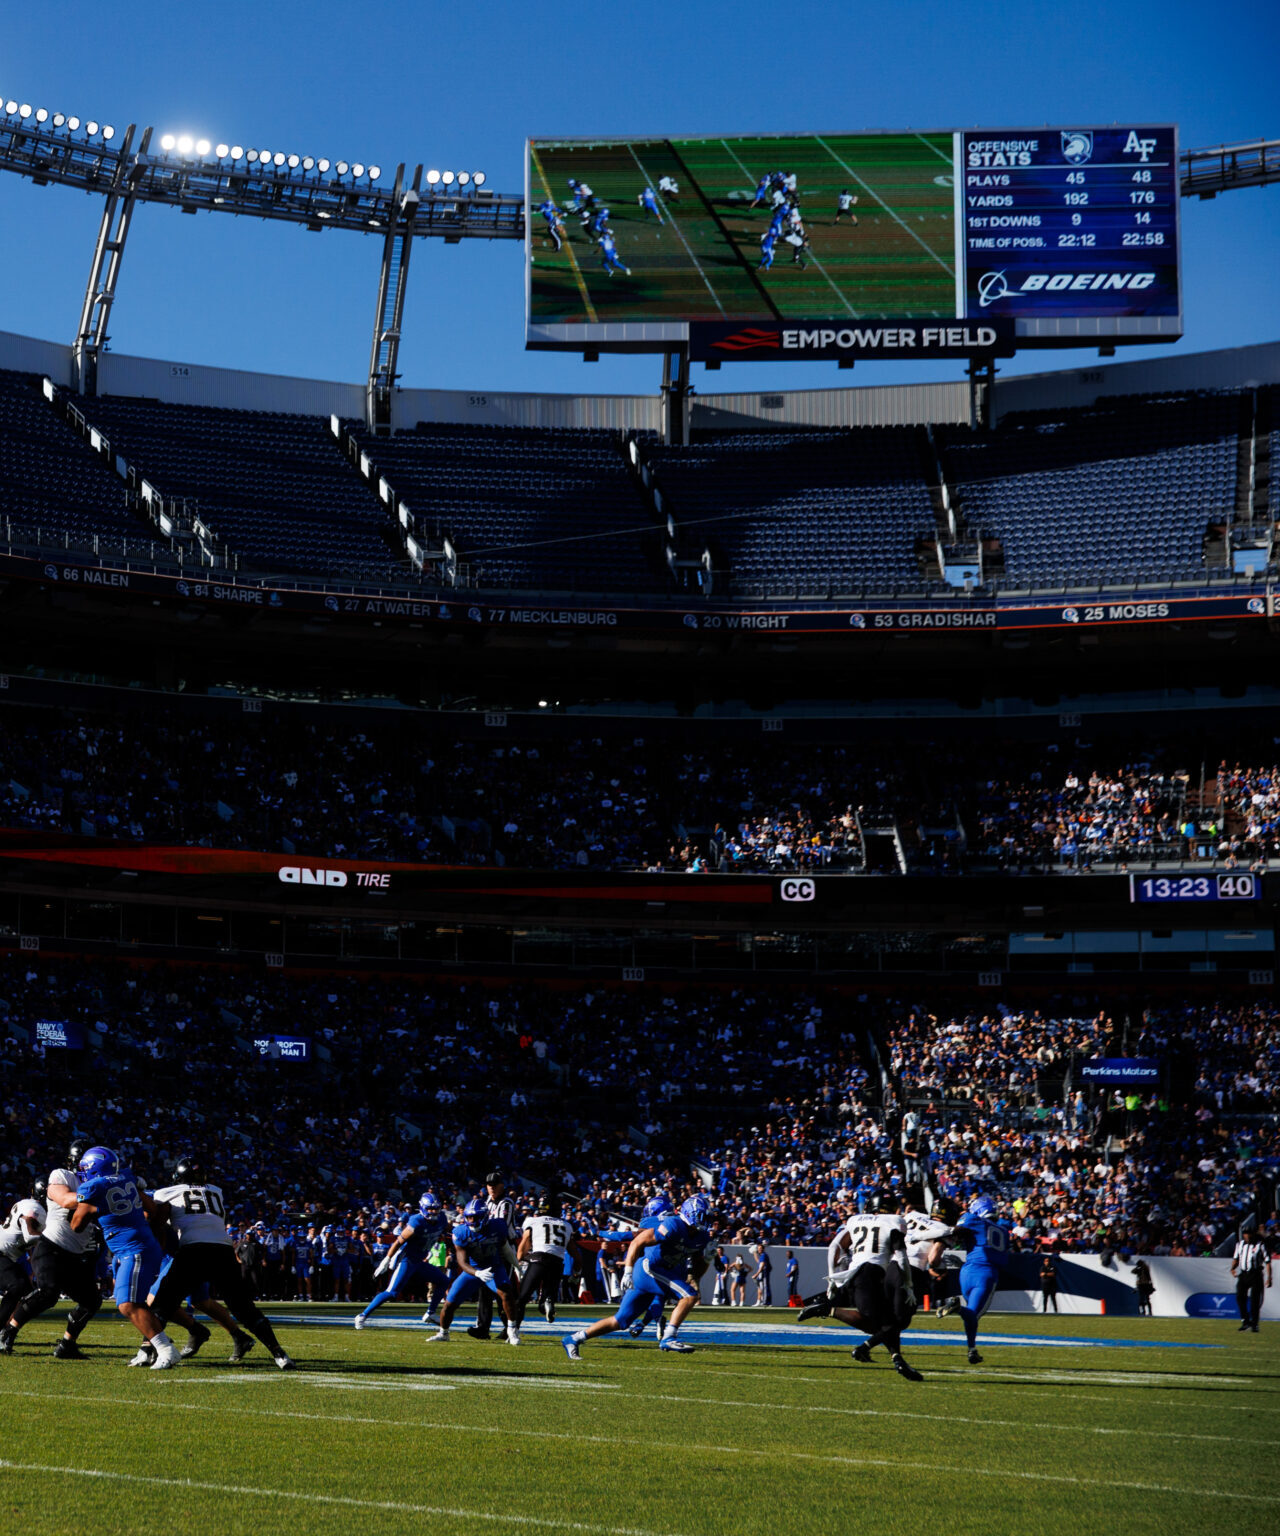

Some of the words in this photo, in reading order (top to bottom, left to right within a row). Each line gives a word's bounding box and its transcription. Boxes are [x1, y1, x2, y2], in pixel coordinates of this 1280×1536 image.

[968, 139, 1039, 152] OFFENSIVE
[969, 152, 1032, 167] STATS
[968, 174, 1010, 187] PLAYS
[1065, 172, 1086, 185] 45
[1132, 170, 1152, 183] 48
[968, 195, 1014, 207] YARDS
[1064, 192, 1089, 205] 192
[1129, 191, 1155, 204] 176
[968, 216, 988, 228] 1ST
[990, 215, 1041, 227] DOWNS
[1071, 213, 1082, 226] 9
[1134, 212, 1151, 225] 14
[968, 237, 996, 248] TIME
[996, 237, 1012, 248] OF
[1013, 236, 1048, 248] POSS.
[1058, 234, 1096, 247] 22:12
[1122, 232, 1165, 246] 22:58
[1020, 272, 1157, 291] BOEING
[782, 328, 917, 349] EMPOWER
[922, 327, 997, 348] FIELD
[172, 367, 189, 377] 514
[470, 396, 487, 406] 515
[63, 569, 79, 581] 66
[83, 570, 129, 588] NALEN
[194, 584, 209, 597] 84
[213, 586, 263, 604] SHARPE
[344, 599, 360, 612] 27
[365, 600, 431, 617] ATWATER
[1084, 607, 1104, 621] 25
[1109, 603, 1169, 620] MOSES
[488, 609, 505, 622] 77
[510, 609, 618, 626] MECKLENBURG
[703, 615, 720, 628] 20
[726, 615, 789, 629] WRIGHT
[874, 613, 893, 627] 53
[898, 612, 997, 628] GRADISHAR
[356, 873, 391, 887] TIRE
[1142, 877, 1210, 898] 13:23
[1220, 876, 1252, 896] 40
[784, 881, 812, 899] CC
[1082, 1066, 1120, 1076] Perkins
[1122, 1066, 1158, 1076] Motors
[183, 1190, 225, 1217] 60
[542, 1223, 567, 1247] 15
[853, 1226, 881, 1253] 21
